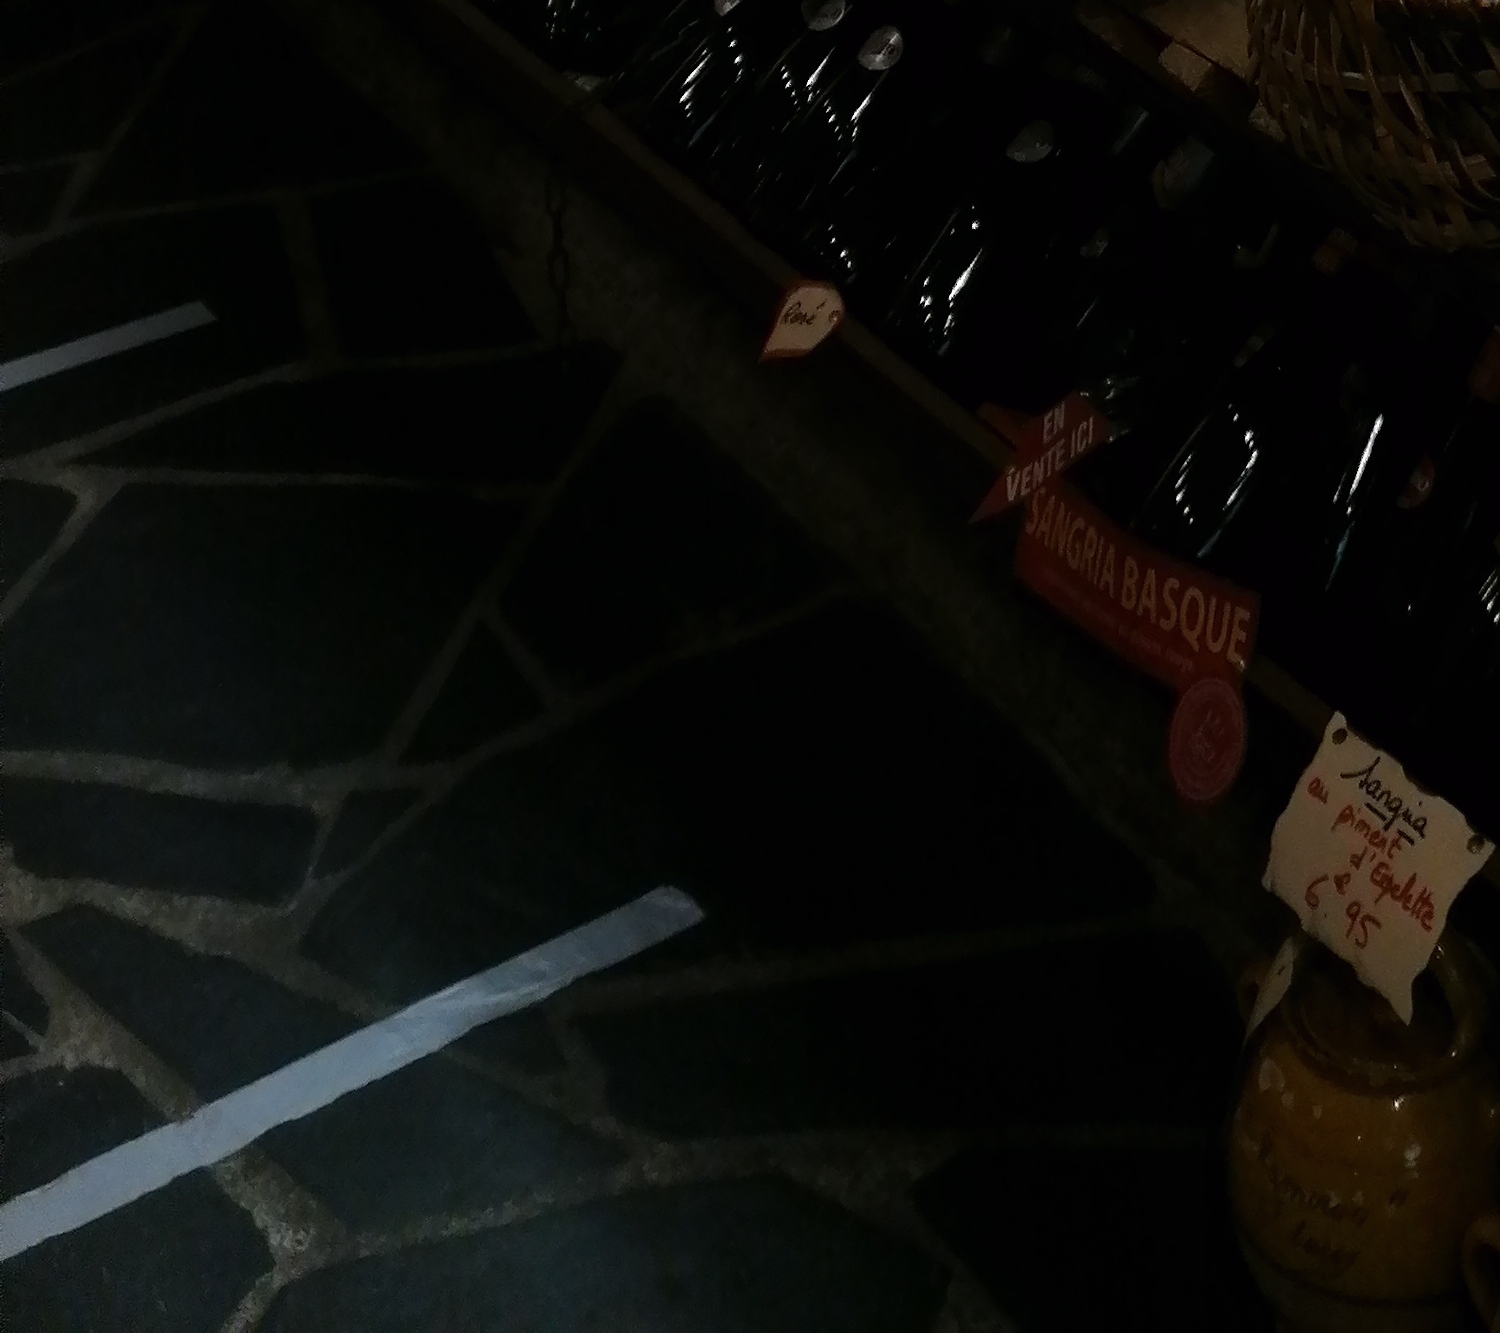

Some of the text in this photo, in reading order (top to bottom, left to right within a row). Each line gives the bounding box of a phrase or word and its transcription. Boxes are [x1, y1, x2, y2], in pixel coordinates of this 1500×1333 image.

[1005, 416, 1094, 503] VENTE ICI
[1042, 401, 1066, 444] EN
[1024, 486, 1117, 600] SANGRIA
[1120, 555, 1251, 673] BASQUE
[1307, 777, 1403, 860] au piment
